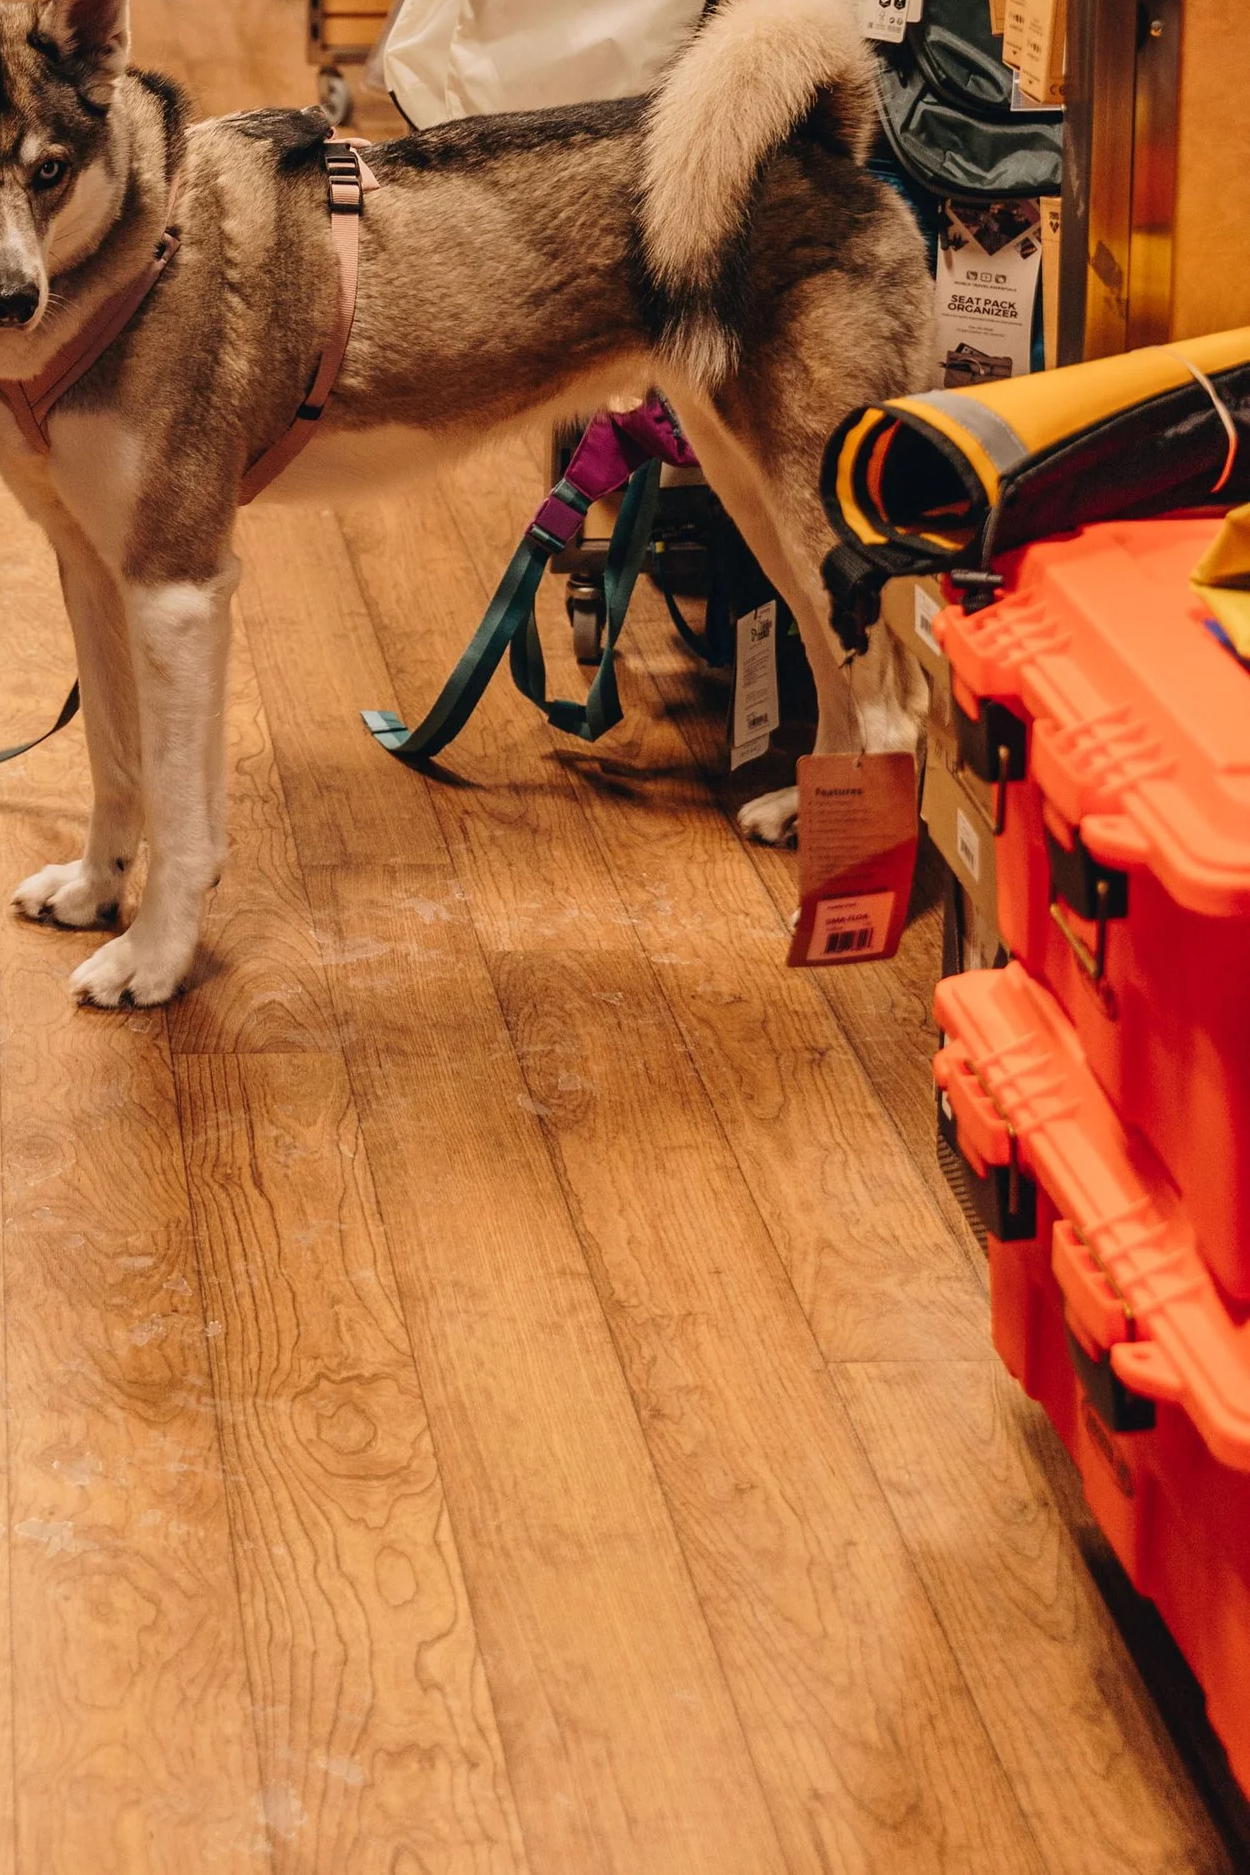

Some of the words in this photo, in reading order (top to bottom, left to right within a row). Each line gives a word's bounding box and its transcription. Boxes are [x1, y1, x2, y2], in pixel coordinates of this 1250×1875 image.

[951, 294, 981, 305] SEAT
[984, 298, 1016, 310] PACK
[947, 302, 1018, 319] ORGANIZER
[815, 787, 863, 797] Features
